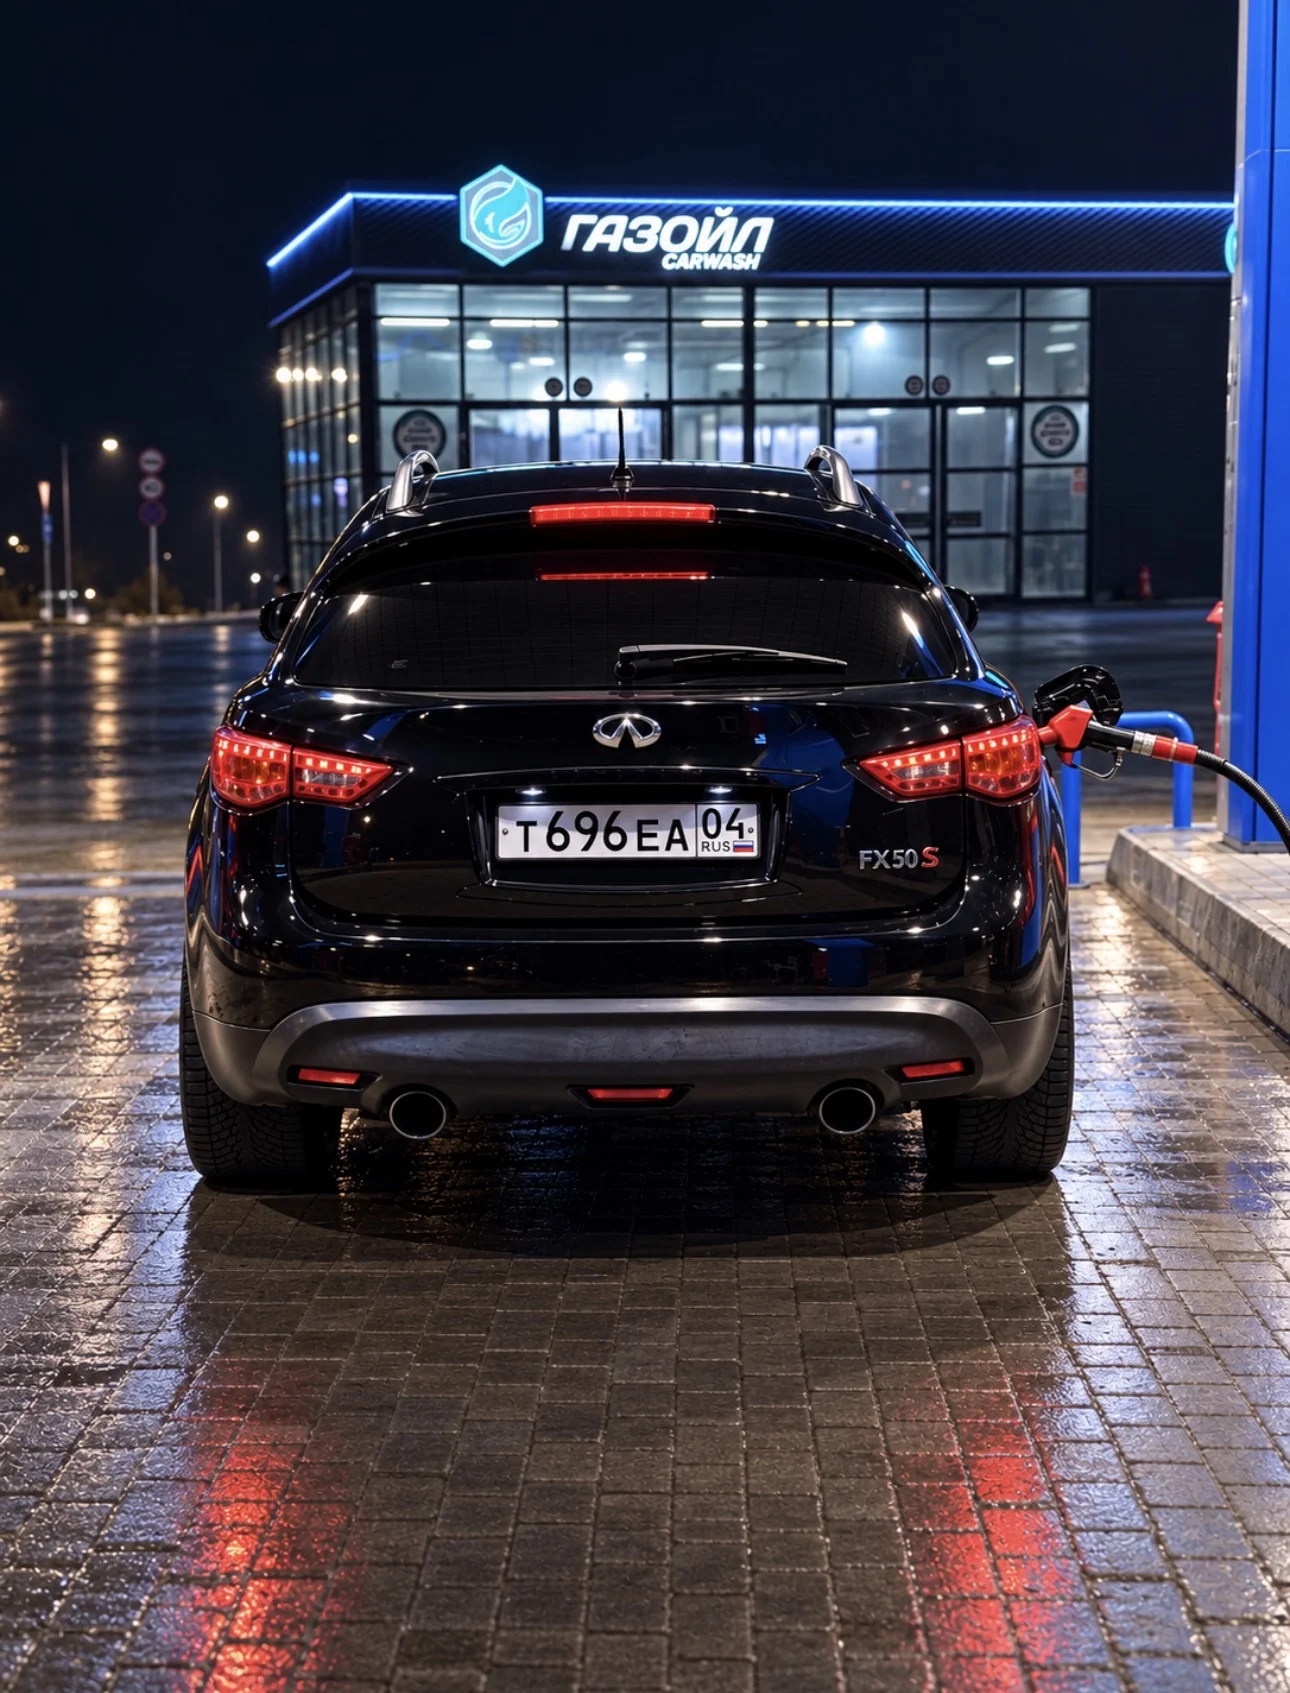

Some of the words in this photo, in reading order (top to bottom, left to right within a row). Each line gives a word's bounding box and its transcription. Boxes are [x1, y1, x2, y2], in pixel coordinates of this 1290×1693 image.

[561, 206, 775, 254] ГАЗОЙЛ
[661, 252, 762, 271] CARWASH
[701, 807, 745, 840] 04
[701, 840, 731, 853] RUS
